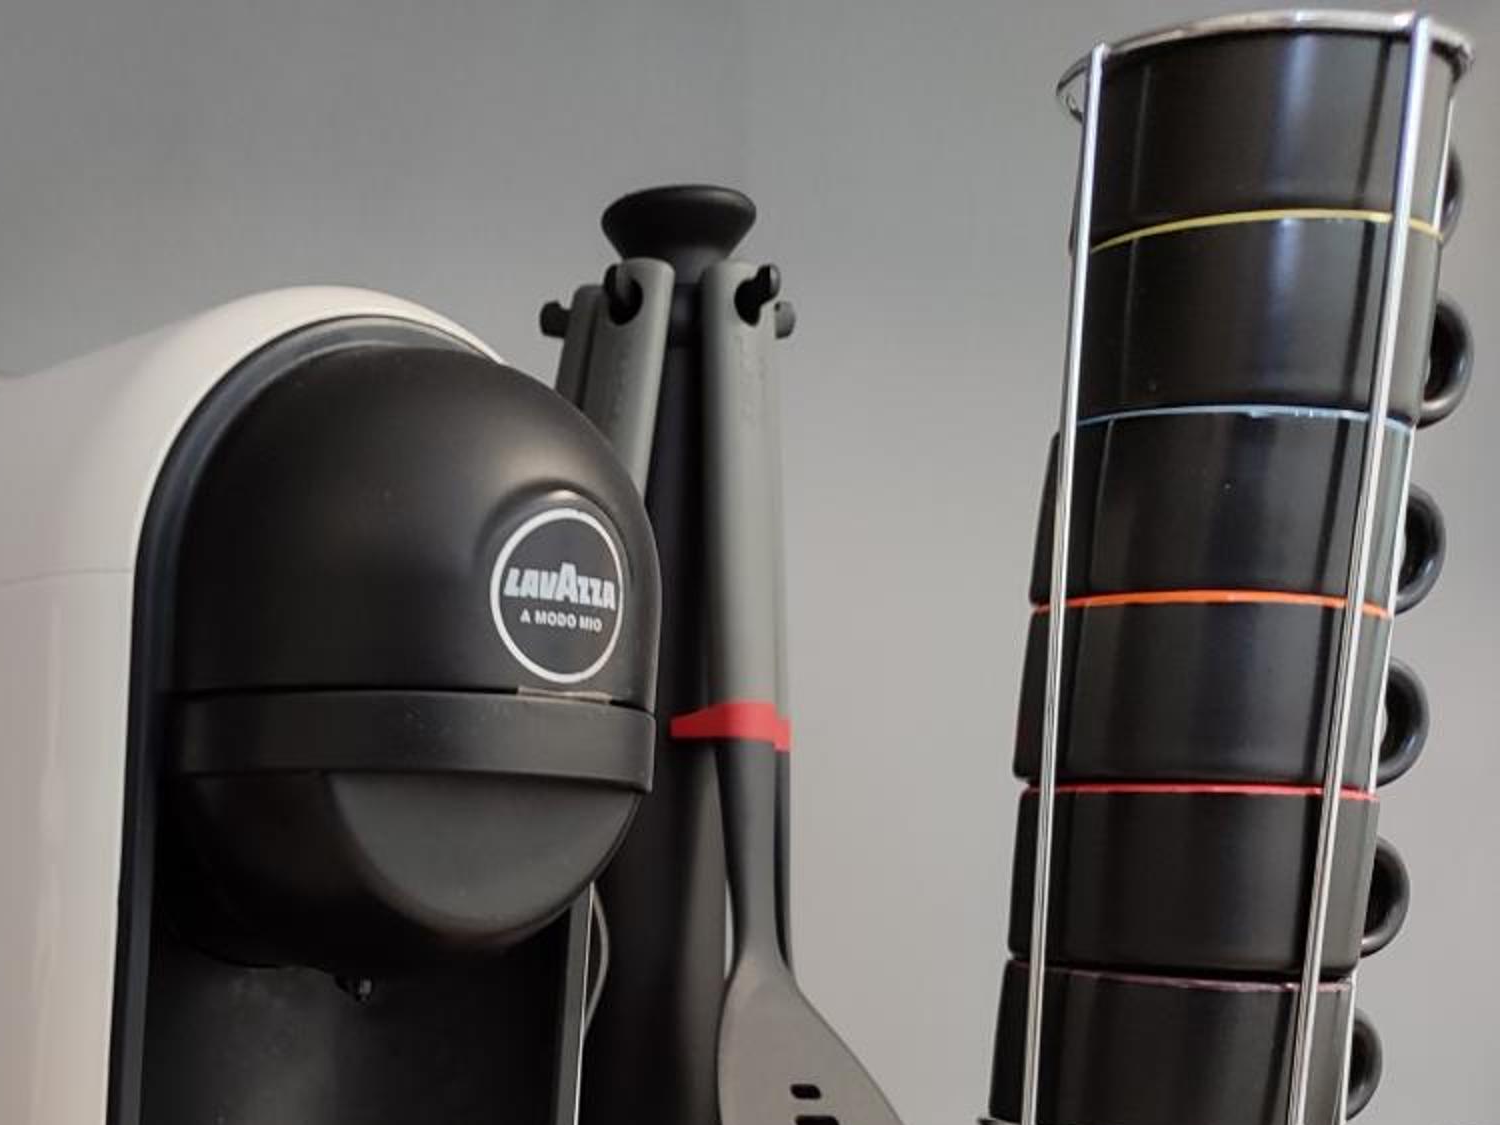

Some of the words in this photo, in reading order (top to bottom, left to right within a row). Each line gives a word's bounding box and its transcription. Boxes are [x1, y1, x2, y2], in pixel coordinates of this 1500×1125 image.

[504, 562, 616, 609] LAVAZZA
[520, 609, 531, 624] A
[535, 611, 577, 628] MODO
[580, 616, 602, 632] MIO
